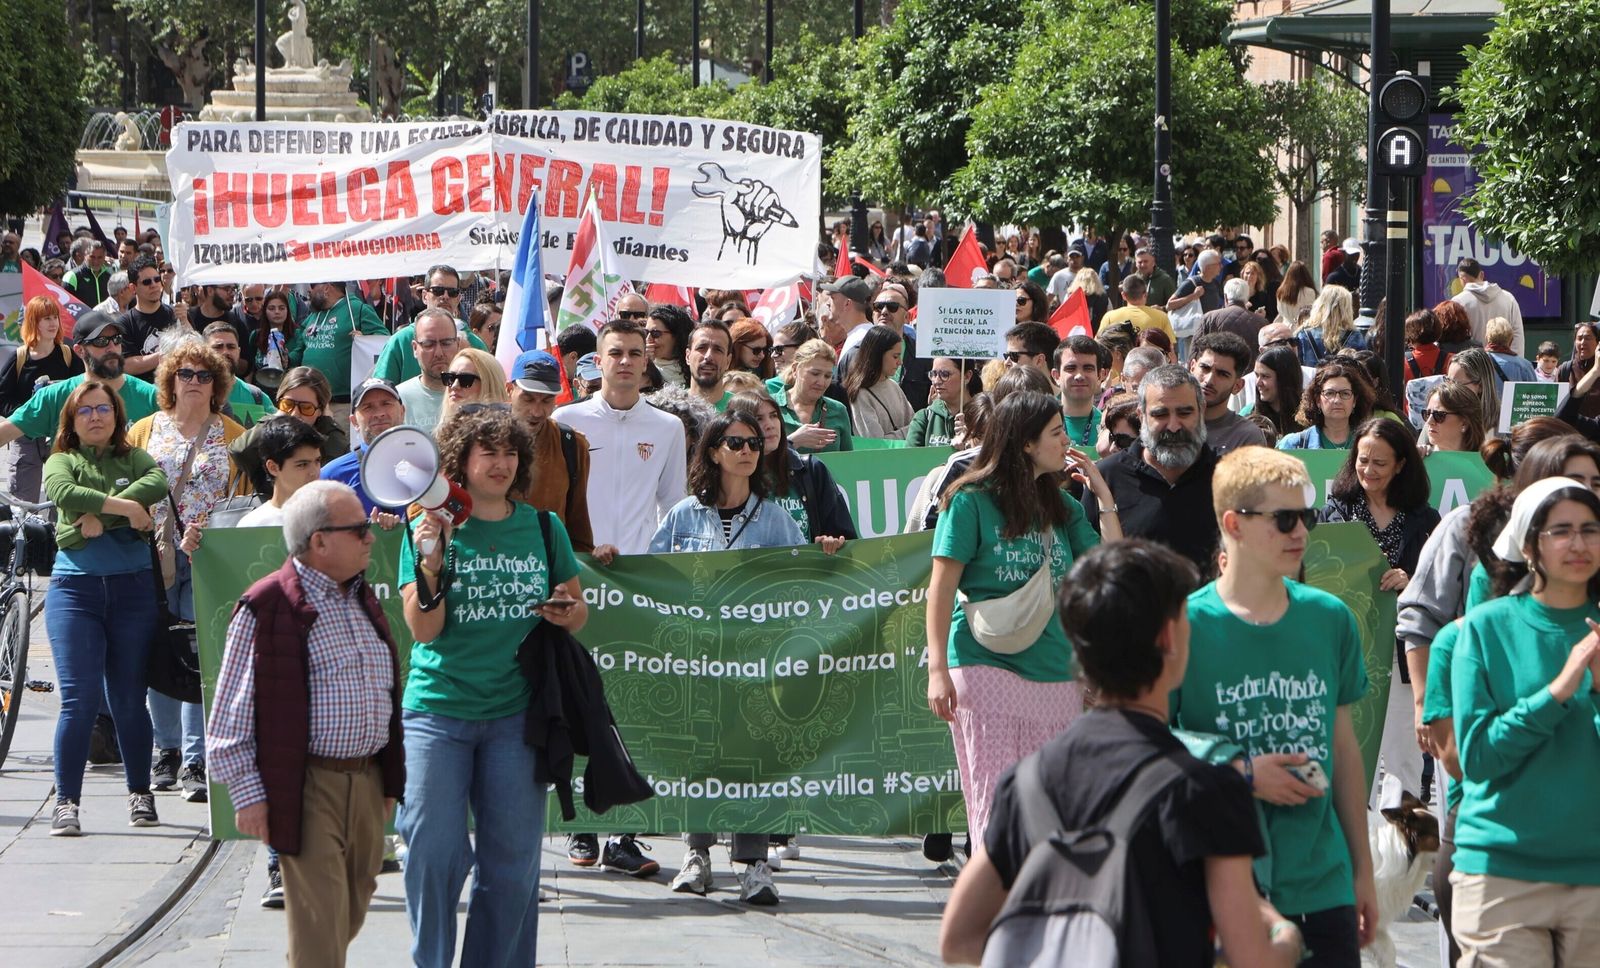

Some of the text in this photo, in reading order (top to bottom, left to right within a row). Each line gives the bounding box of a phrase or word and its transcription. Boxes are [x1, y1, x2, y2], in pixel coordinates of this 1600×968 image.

[187, 129, 241, 153] PARA
[248, 130, 353, 154] DEFENDER
[361, 130, 400, 154] UNA
[488, 111, 566, 143] ÚBLICA,
[574, 117, 599, 142] DE
[605, 117, 693, 147] CALIDAD
[702, 125, 715, 149] Y
[721, 126, 805, 159] SEGURA
[1390, 136, 1410, 165] A
[192, 151, 671, 236] ¡HUELGA GENERAL!
[194, 232, 441, 265] IZQUIERDA REVOLUCIONARIA
[541, 230, 560, 249] de
[943, 317, 988, 326] CRECEN, LA
[948, 307, 963, 315] LAS
[965, 308, 994, 316] RATIOS
[934, 326, 996, 336] ATENCIÓN BAJA
[720, 598, 810, 623] seguro
[817, 597, 833, 620] y
[624, 650, 767, 678] Profesional
[774, 657, 809, 677] de
[818, 652, 895, 676] Danza
